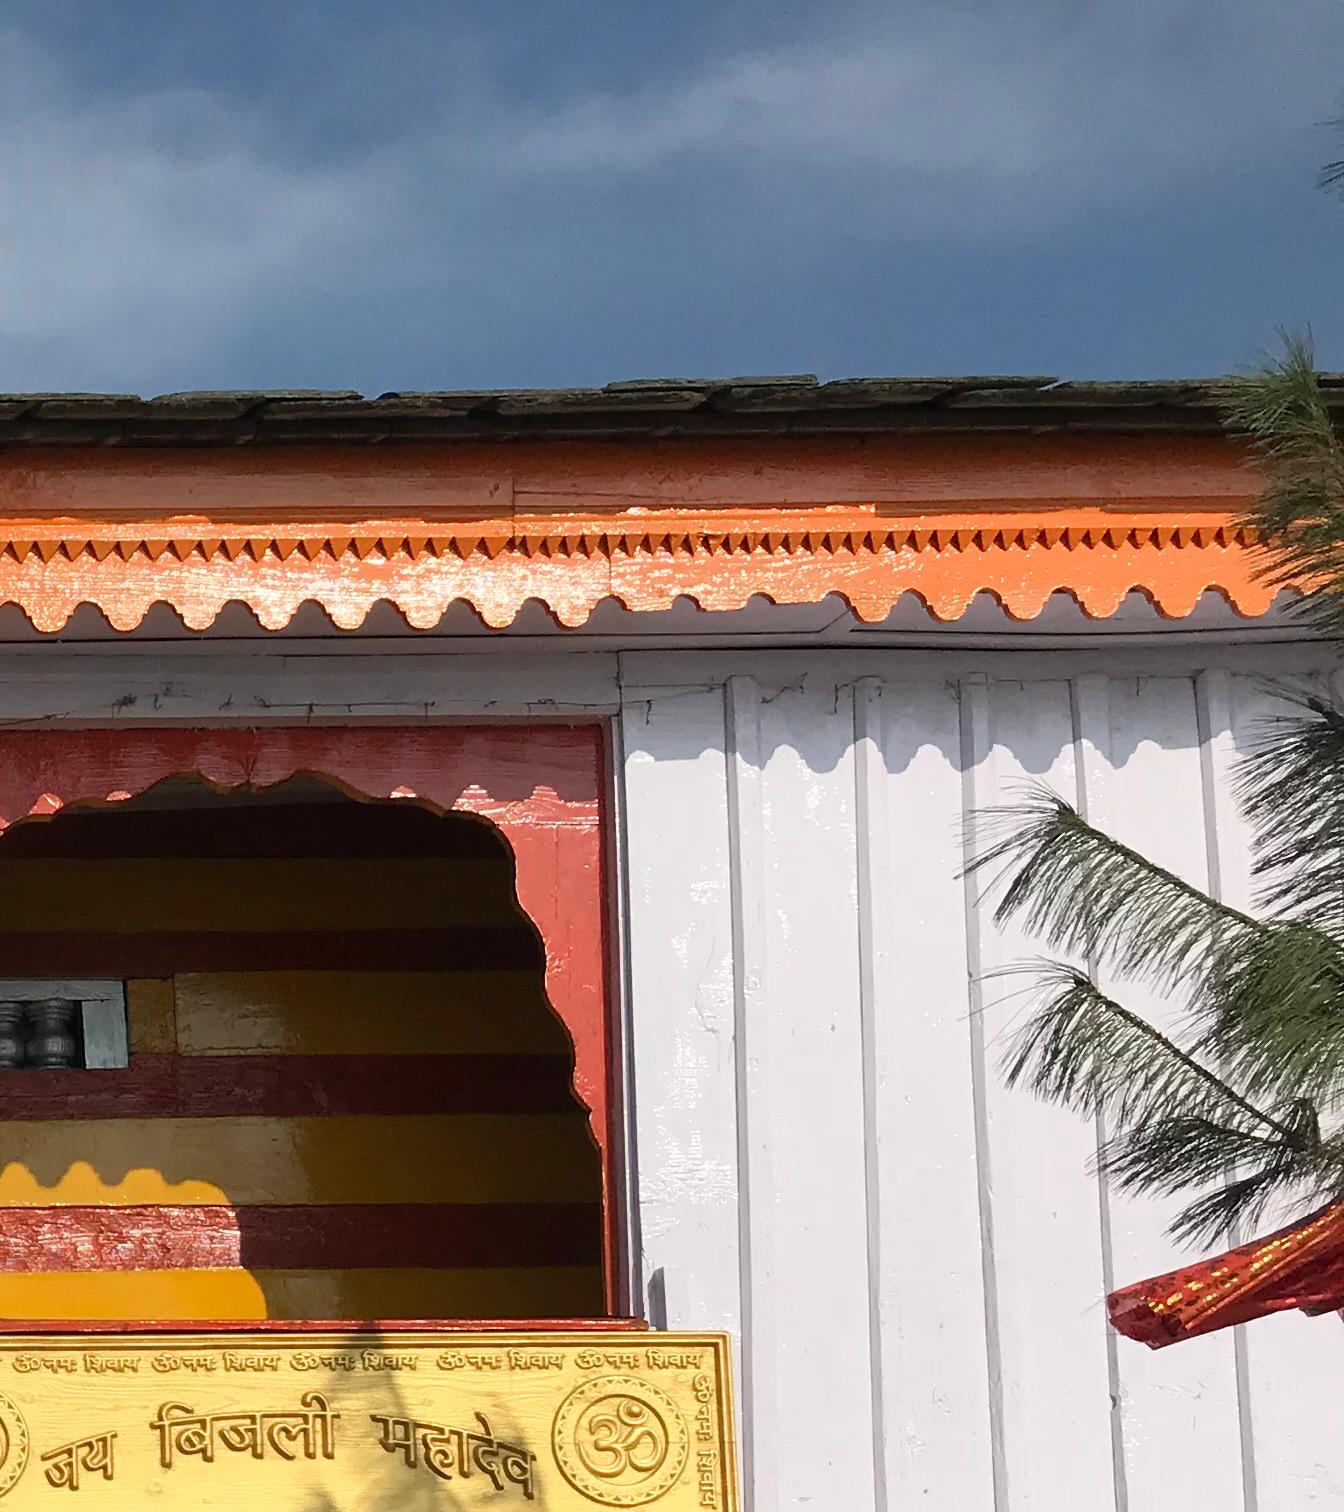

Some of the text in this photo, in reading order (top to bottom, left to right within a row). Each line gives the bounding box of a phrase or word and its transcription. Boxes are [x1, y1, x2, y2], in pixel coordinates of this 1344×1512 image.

[224, 1352, 280, 1371] शिवाय
[647, 1349, 703, 1369] शिवाय
[40, 1392, 537, 1499] जय बिजली महादेव
